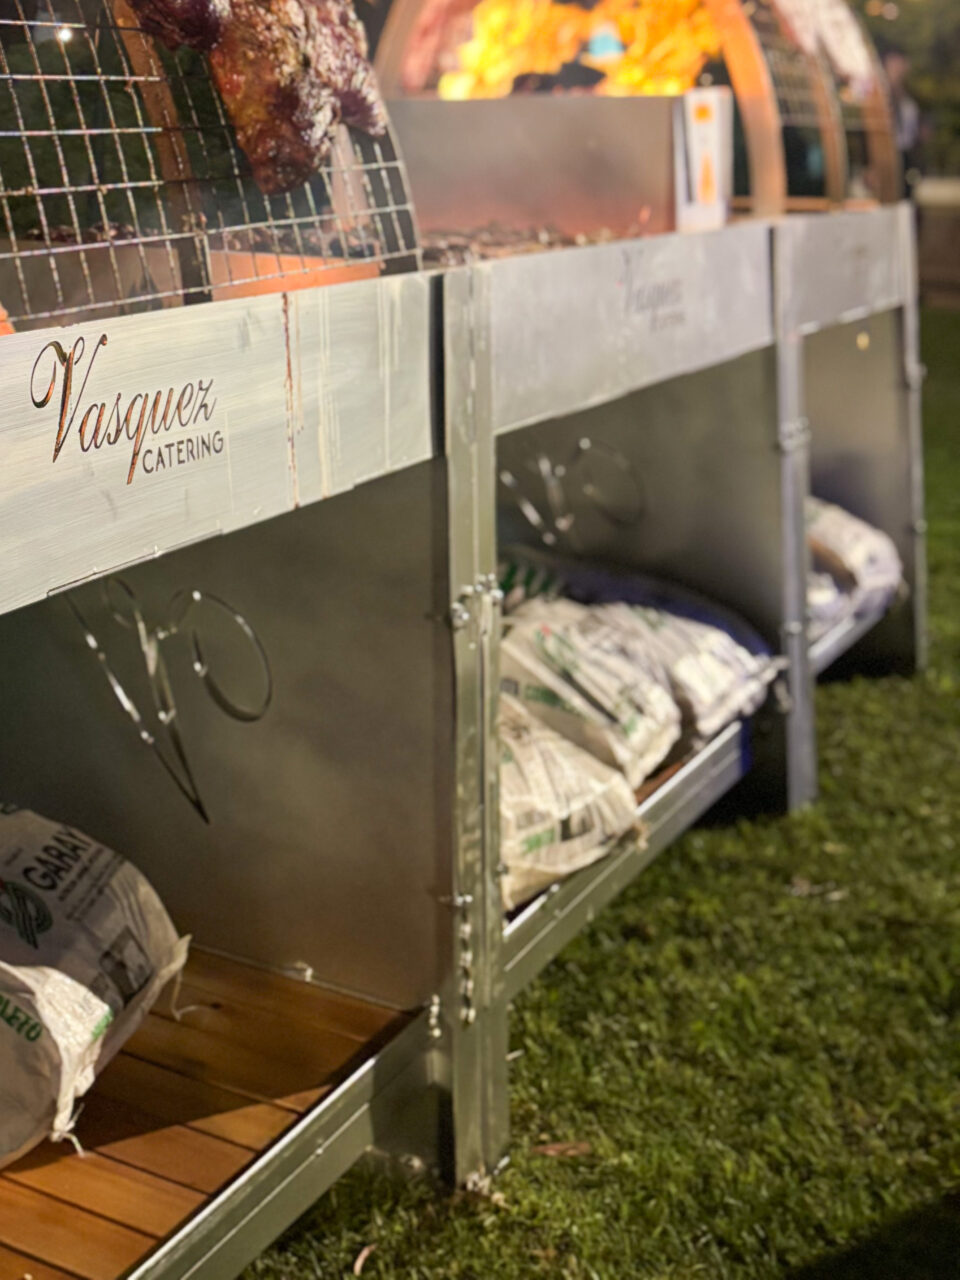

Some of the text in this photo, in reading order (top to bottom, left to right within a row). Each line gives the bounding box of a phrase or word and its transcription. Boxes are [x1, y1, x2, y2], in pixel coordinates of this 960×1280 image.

[30, 333, 217, 486] Vasquez
[141, 430, 225, 475] CATERING
[22, 824, 93, 891] GARAY
